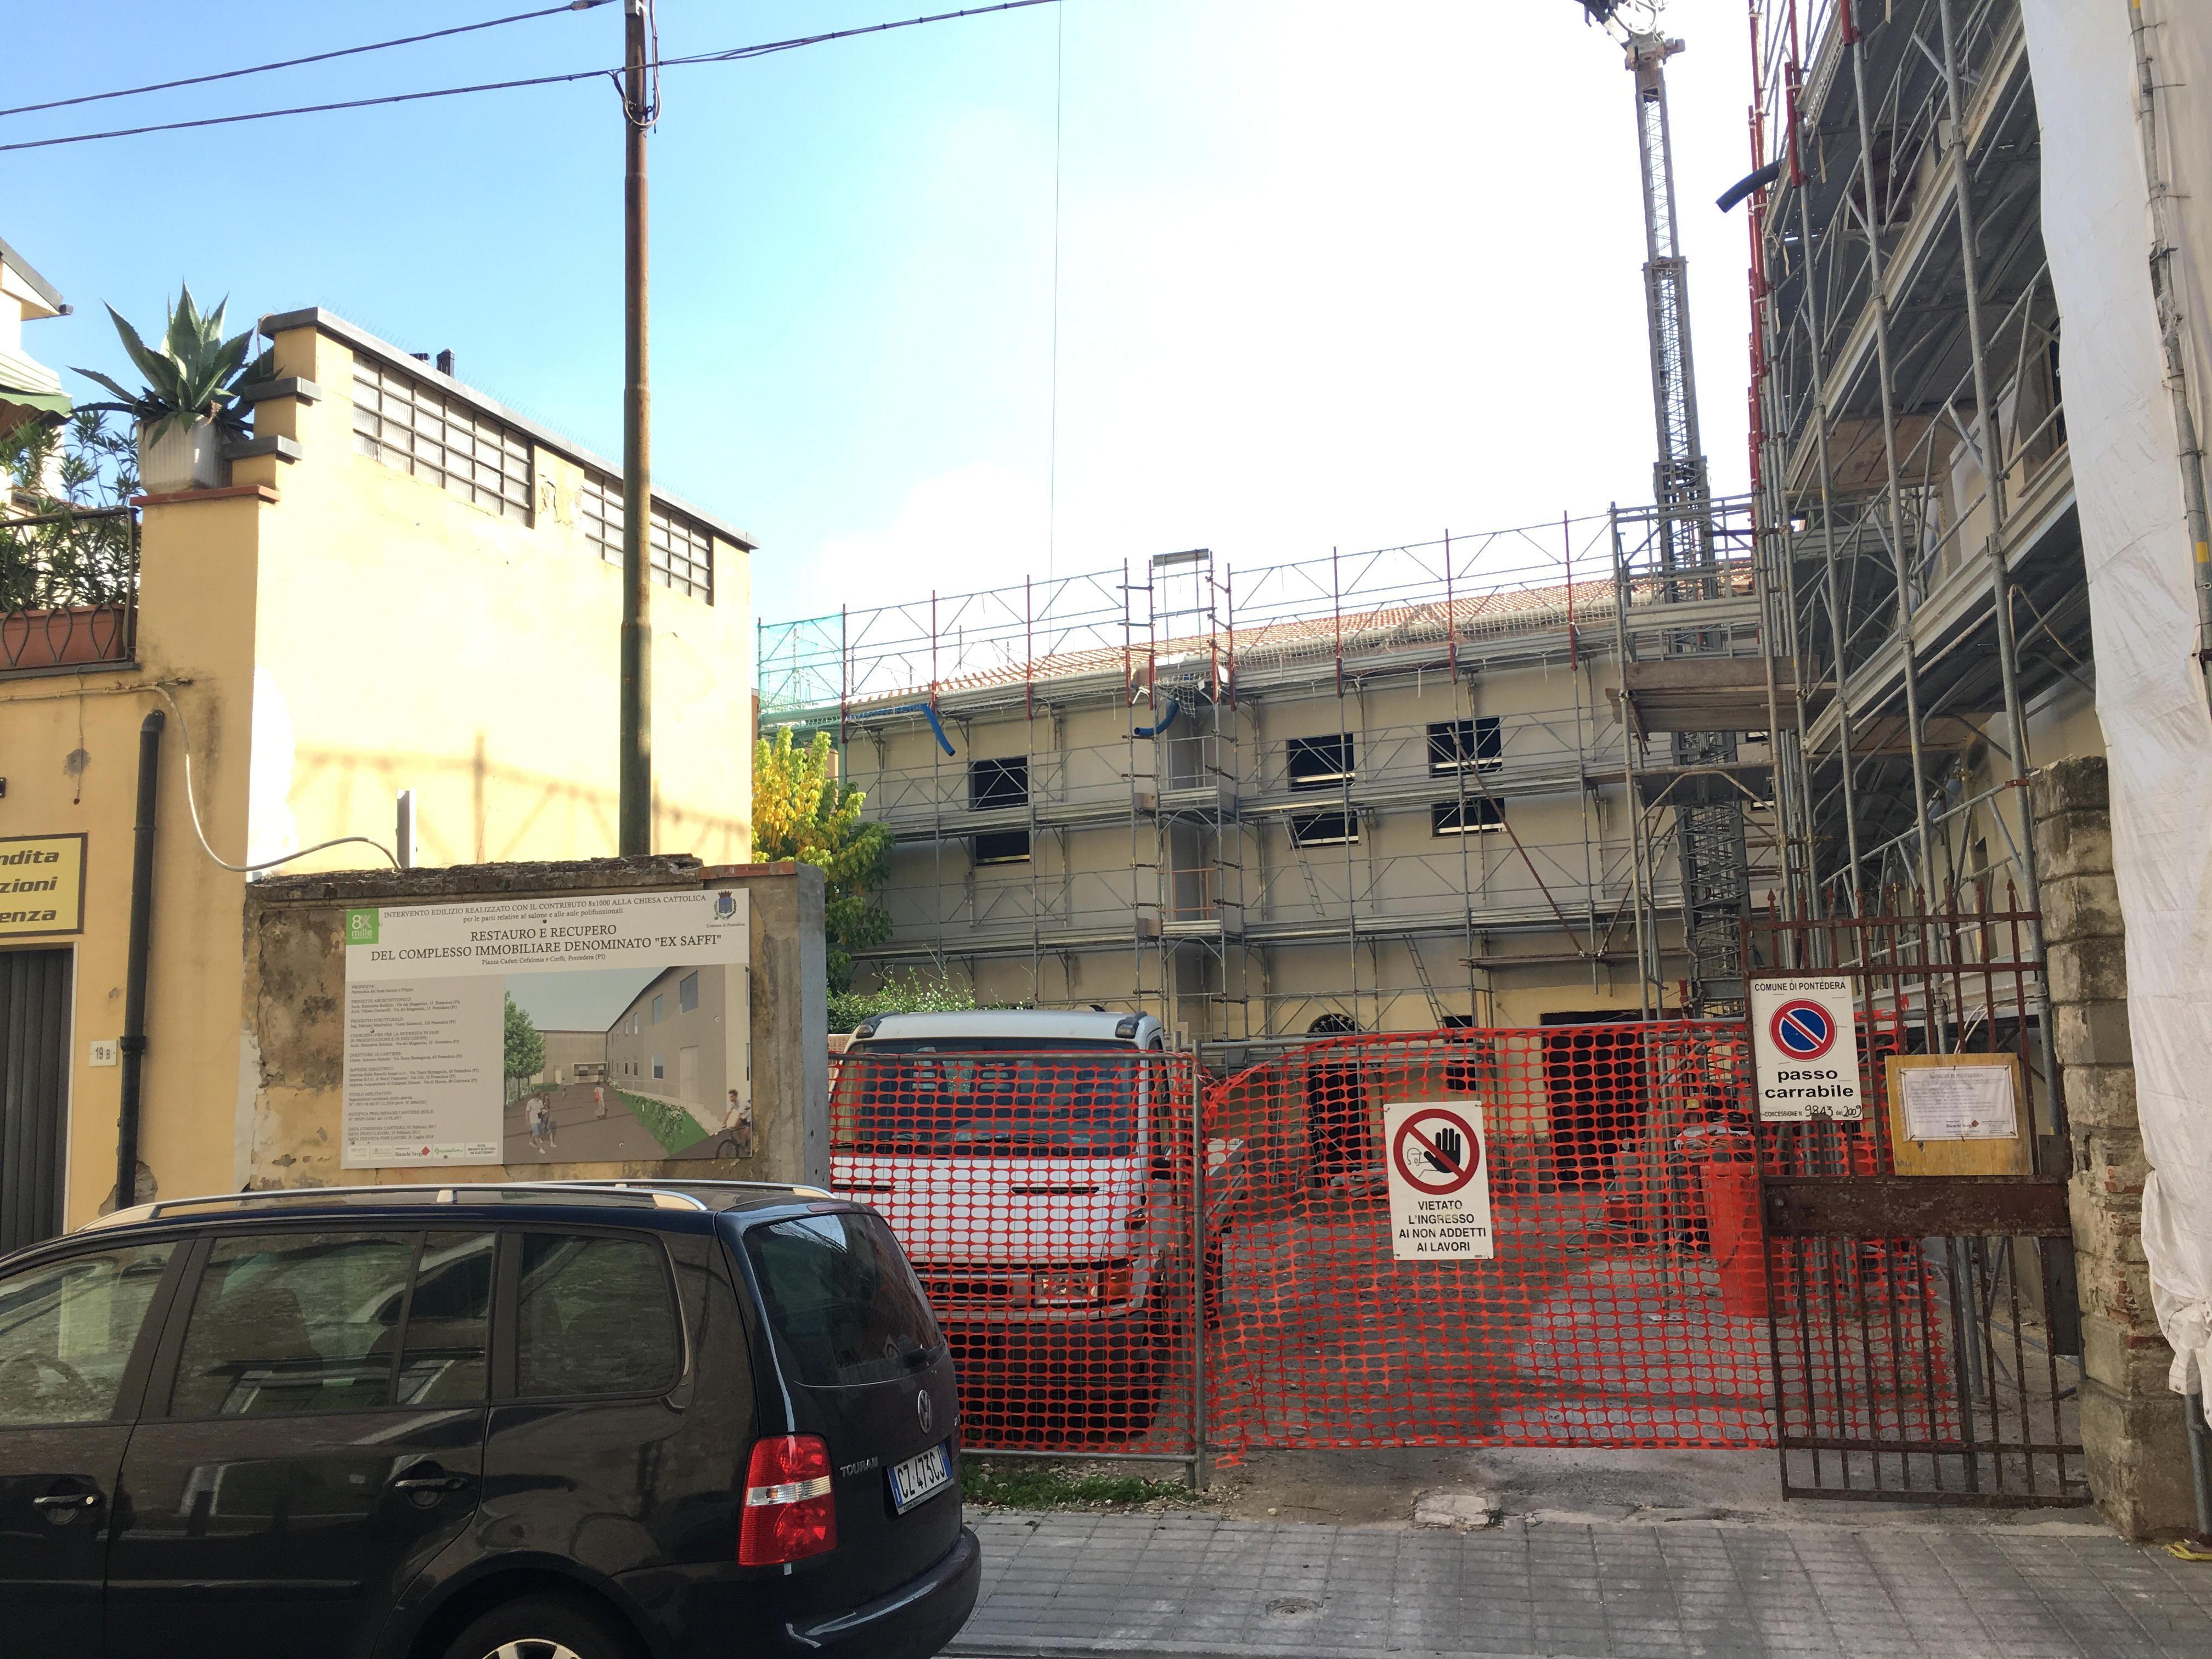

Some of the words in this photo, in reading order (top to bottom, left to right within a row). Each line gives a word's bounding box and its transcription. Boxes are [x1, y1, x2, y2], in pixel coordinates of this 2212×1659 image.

[0, 850, 59, 865] ndita
[0, 876, 58, 893] zioni
[384, 910, 429, 918] INTERVENTO
[431, 908, 463, 916] EDILIZIO
[465, 905, 510, 914] REALIZZATO
[539, 901, 586, 910] CONTRIBUTO
[634, 896, 662, 905] CHIESA
[663, 895, 706, 903] CATTOLICA
[0, 910, 57, 923] enza
[481, 914, 495, 922] parti
[580, 907, 623, 917] polifunzionali
[352, 928, 373, 937] mille
[470, 928, 536, 941] RESTAURO
[539, 928, 547, 938] E
[550, 924, 617, 938] RECUPERO
[371, 950, 396, 961] DEL
[399, 946, 472, 960] COMPLESSO
[475, 941, 561, 956] IMMOBILIARE
[564, 937, 652, 952] DENOMINATO
[655, 937, 677, 947] "EX
[680, 934, 722, 946] SAFFI"
[1754, 983, 1787, 991] COMUNE
[1790, 982, 1797, 990] DI
[1799, 981, 1846, 990] PONTEDERA
[95, 1047, 104, 1060] 19
[106, 1049, 111, 1059] B
[1778, 1069, 1838, 1084] passo
[1764, 1084, 1854, 1098] carrabile
[1843, 1105, 1862, 1118] 2009
[1418, 1200, 1463, 1210] VIETATO
[1408, 1214, 1475, 1224] L'INGRESSO
[1399, 1229, 1409, 1238] AI
[1413, 1228, 1436, 1238] NON
[1440, 1227, 1486, 1238] ADDETTI
[1417, 1242, 1427, 1252] AI
[1430, 1242, 1470, 1252] LAVORI
[840, 1456, 878, 1477] TOURAN
